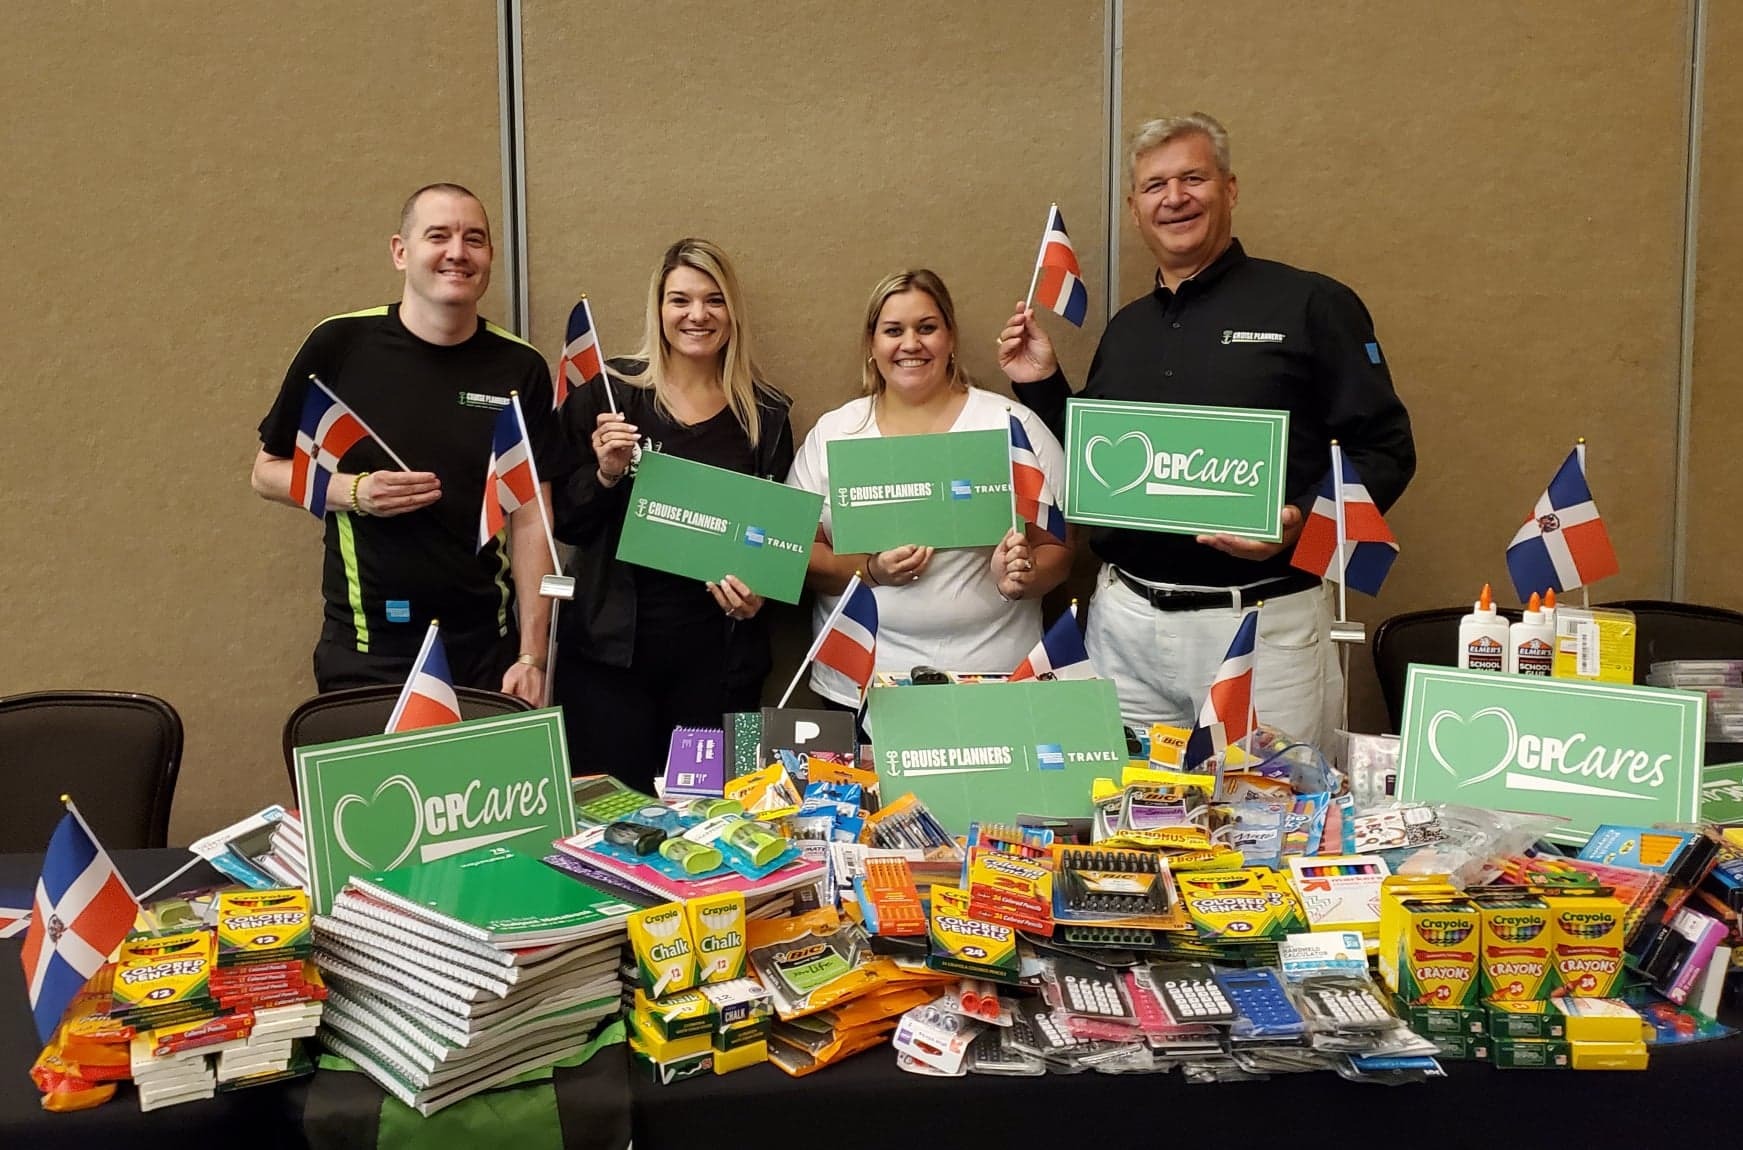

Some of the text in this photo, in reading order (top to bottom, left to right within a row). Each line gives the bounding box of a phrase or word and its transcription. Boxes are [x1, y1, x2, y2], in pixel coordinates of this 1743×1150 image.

[1153, 447, 1265, 488] CPCares
[849, 482, 931, 500] CRUISE PLANNERS
[647, 501, 728, 533] CRUISE PLANNERS
[767, 537, 805, 554] TRAVEL
[901, 746, 1012, 769] CRUISE PLANNERS
[1067, 751, 1119, 762] TRAVEL
[1517, 733, 1672, 787] CPCares
[424, 777, 550, 836] CPCares
[702, 903, 738, 916] Crayola
[1191, 897, 1266, 908] COLORED
[1200, 903, 1266, 914] PENCILS
[223, 912, 306, 924] COLORED
[229, 918, 303, 931] PENCILS
[644, 910, 678, 925] Crayola
[936, 915, 1010, 934] COLORED
[1421, 919, 1469, 931] Crayola
[1493, 915, 1541, 927] Crayola
[1562, 912, 1613, 924] Crayola
[940, 923, 1009, 942] PENCILS
[1230, 923, 1250, 931] 12
[650, 940, 690, 962] Chalk
[701, 934, 742, 953] Chalk
[965, 946, 984, 957] 24
[120, 959, 206, 977] COLORED
[1490, 964, 1544, 977] CRAYONS
[1560, 959, 1616, 974] CRAYONS
[125, 966, 201, 984] PENCILS
[1416, 967, 1470, 982] CRAYONS
[151, 988, 172, 999] 12
[723, 1007, 747, 1022] CHALK
